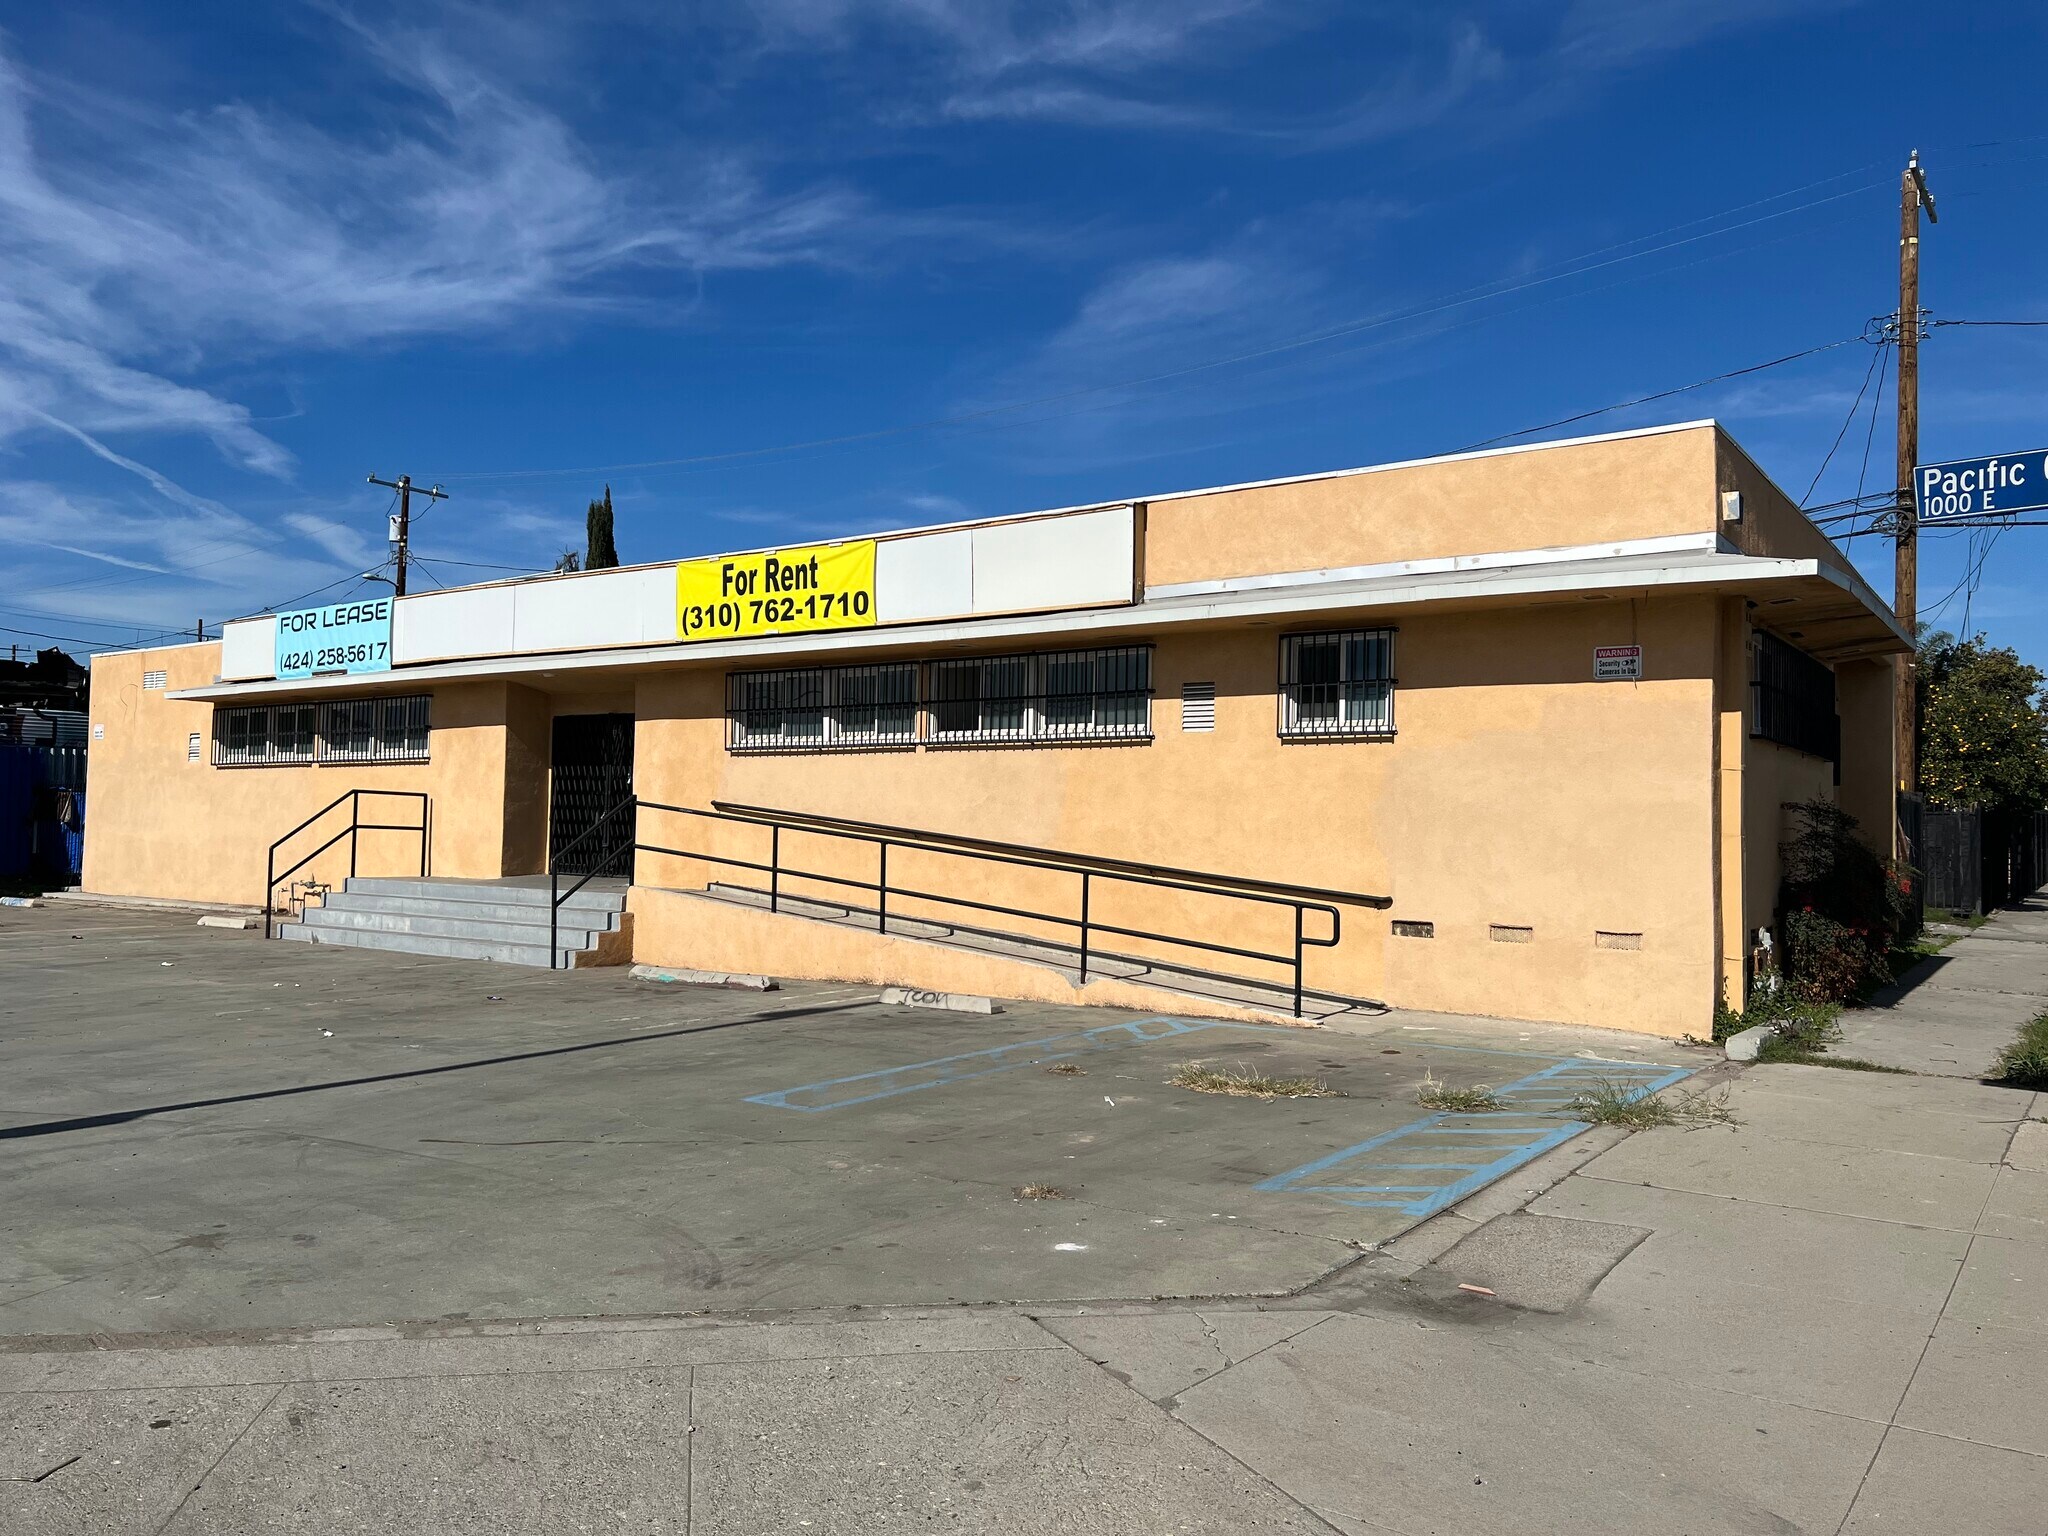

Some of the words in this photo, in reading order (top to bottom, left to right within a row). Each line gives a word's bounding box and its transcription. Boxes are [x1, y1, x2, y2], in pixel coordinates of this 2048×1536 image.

[1924, 460, 2025, 497] Pacific
[1924, 493, 1971, 516] 1000
[1983, 490, 1995, 510] E
[722, 563, 758, 597] For
[765, 554, 818, 593] Rent
[280, 612, 316, 634] FOR
[323, 602, 388, 628] LEASE
[682, 602, 741, 636] (310)
[750, 591, 869, 624] 762-1710
[280, 650, 313, 672] (424)
[317, 642, 387, 666] 258-5617
[1597, 648, 1637, 657] WARNING
[1599, 660, 1620, 668] Security
